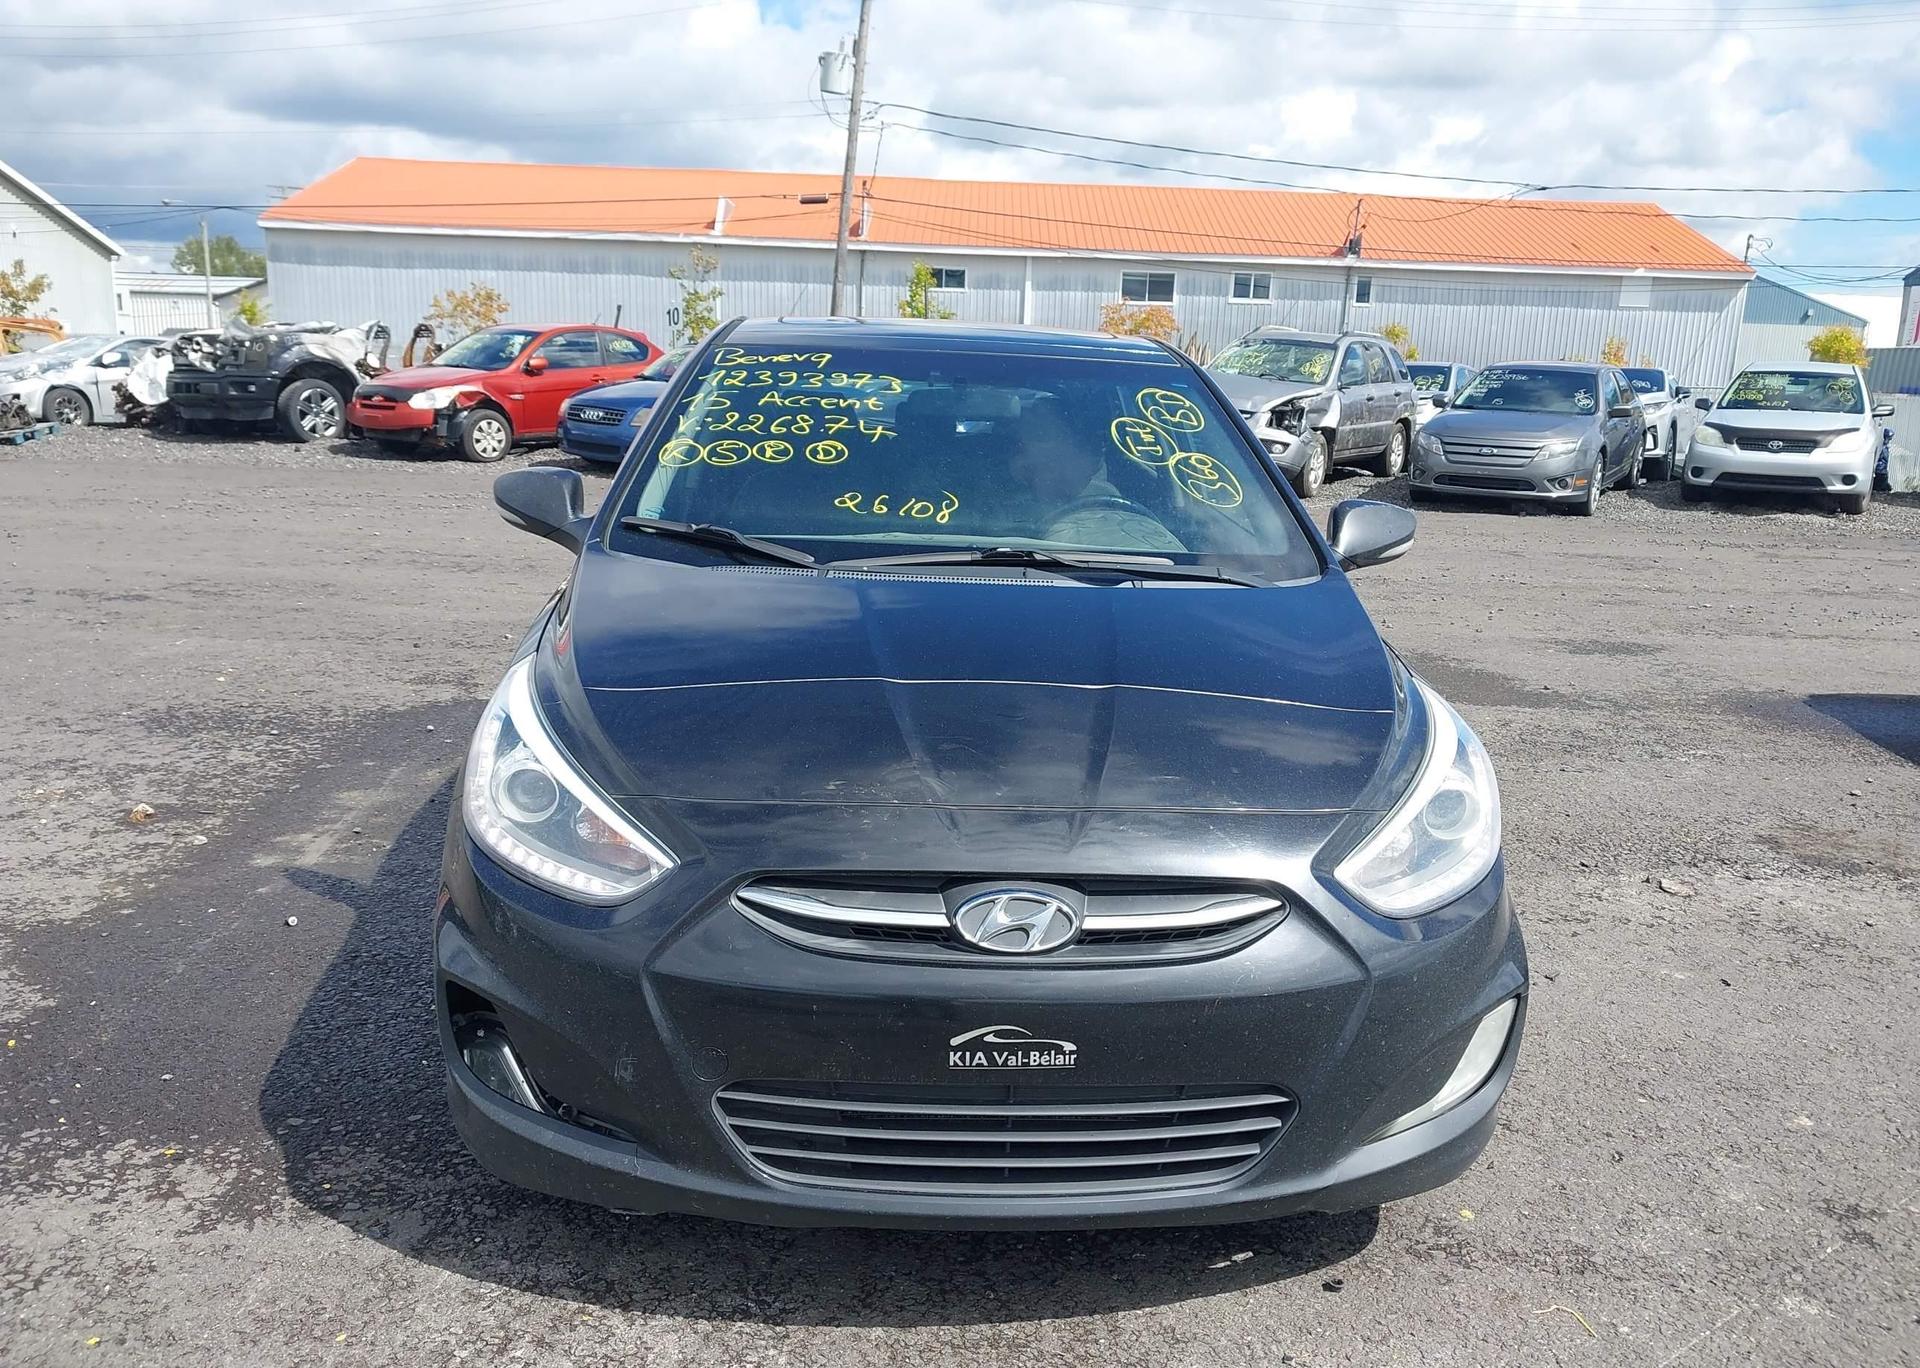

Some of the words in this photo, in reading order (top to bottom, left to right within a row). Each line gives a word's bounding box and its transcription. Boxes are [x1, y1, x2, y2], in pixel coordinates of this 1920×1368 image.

[666, 307, 680, 326] 10
[698, 369, 902, 393] 12393973
[681, 390, 739, 411] 15
[757, 391, 884, 410] Accent
[949, 1051, 989, 1067] KIA
[992, 1049, 1078, 1067] Val-Bélair
